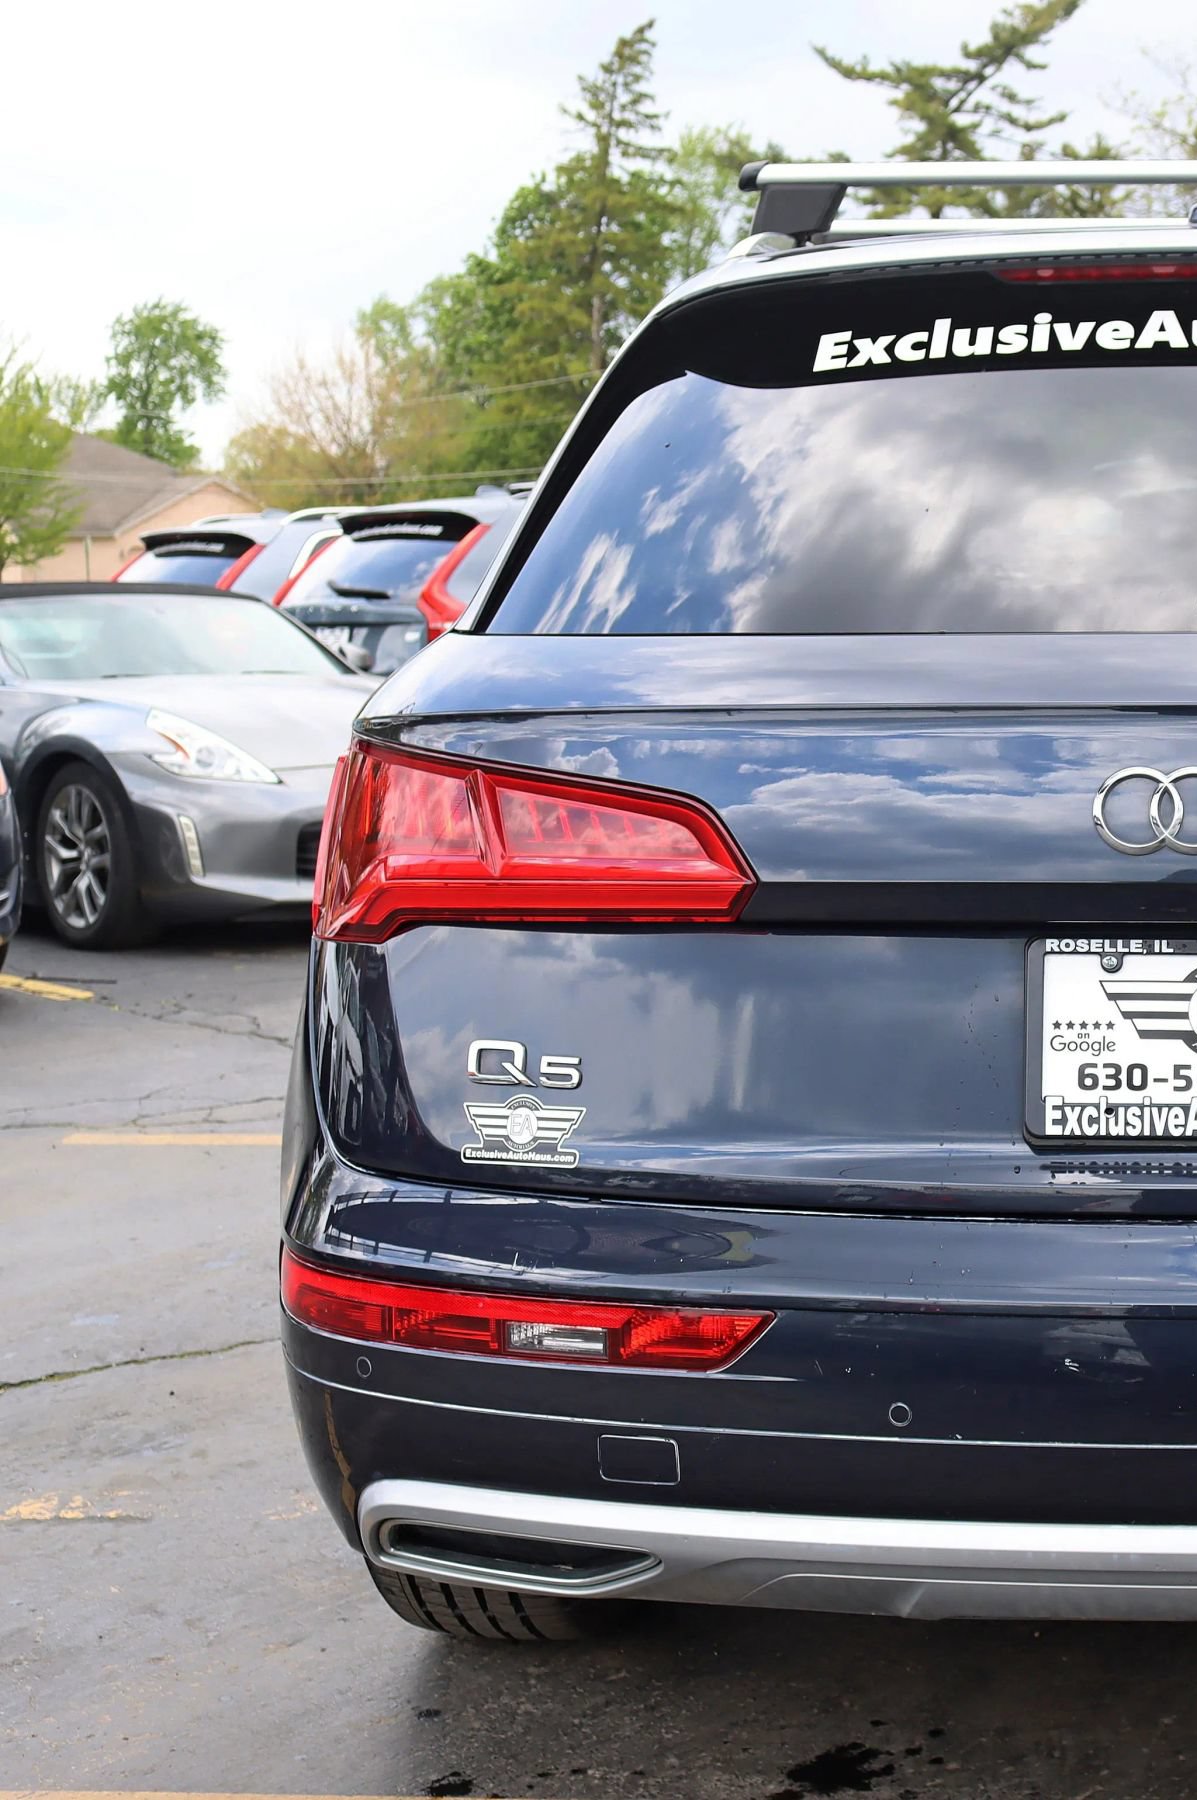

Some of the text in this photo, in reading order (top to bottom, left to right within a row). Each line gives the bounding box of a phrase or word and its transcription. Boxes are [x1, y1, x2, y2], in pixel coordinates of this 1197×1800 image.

[1045, 938, 1175, 955] ROSELLE, IL
[1050, 1034, 1116, 1057] Google
[465, 1148, 575, 1163] ExclusiveAutoHaus.com
